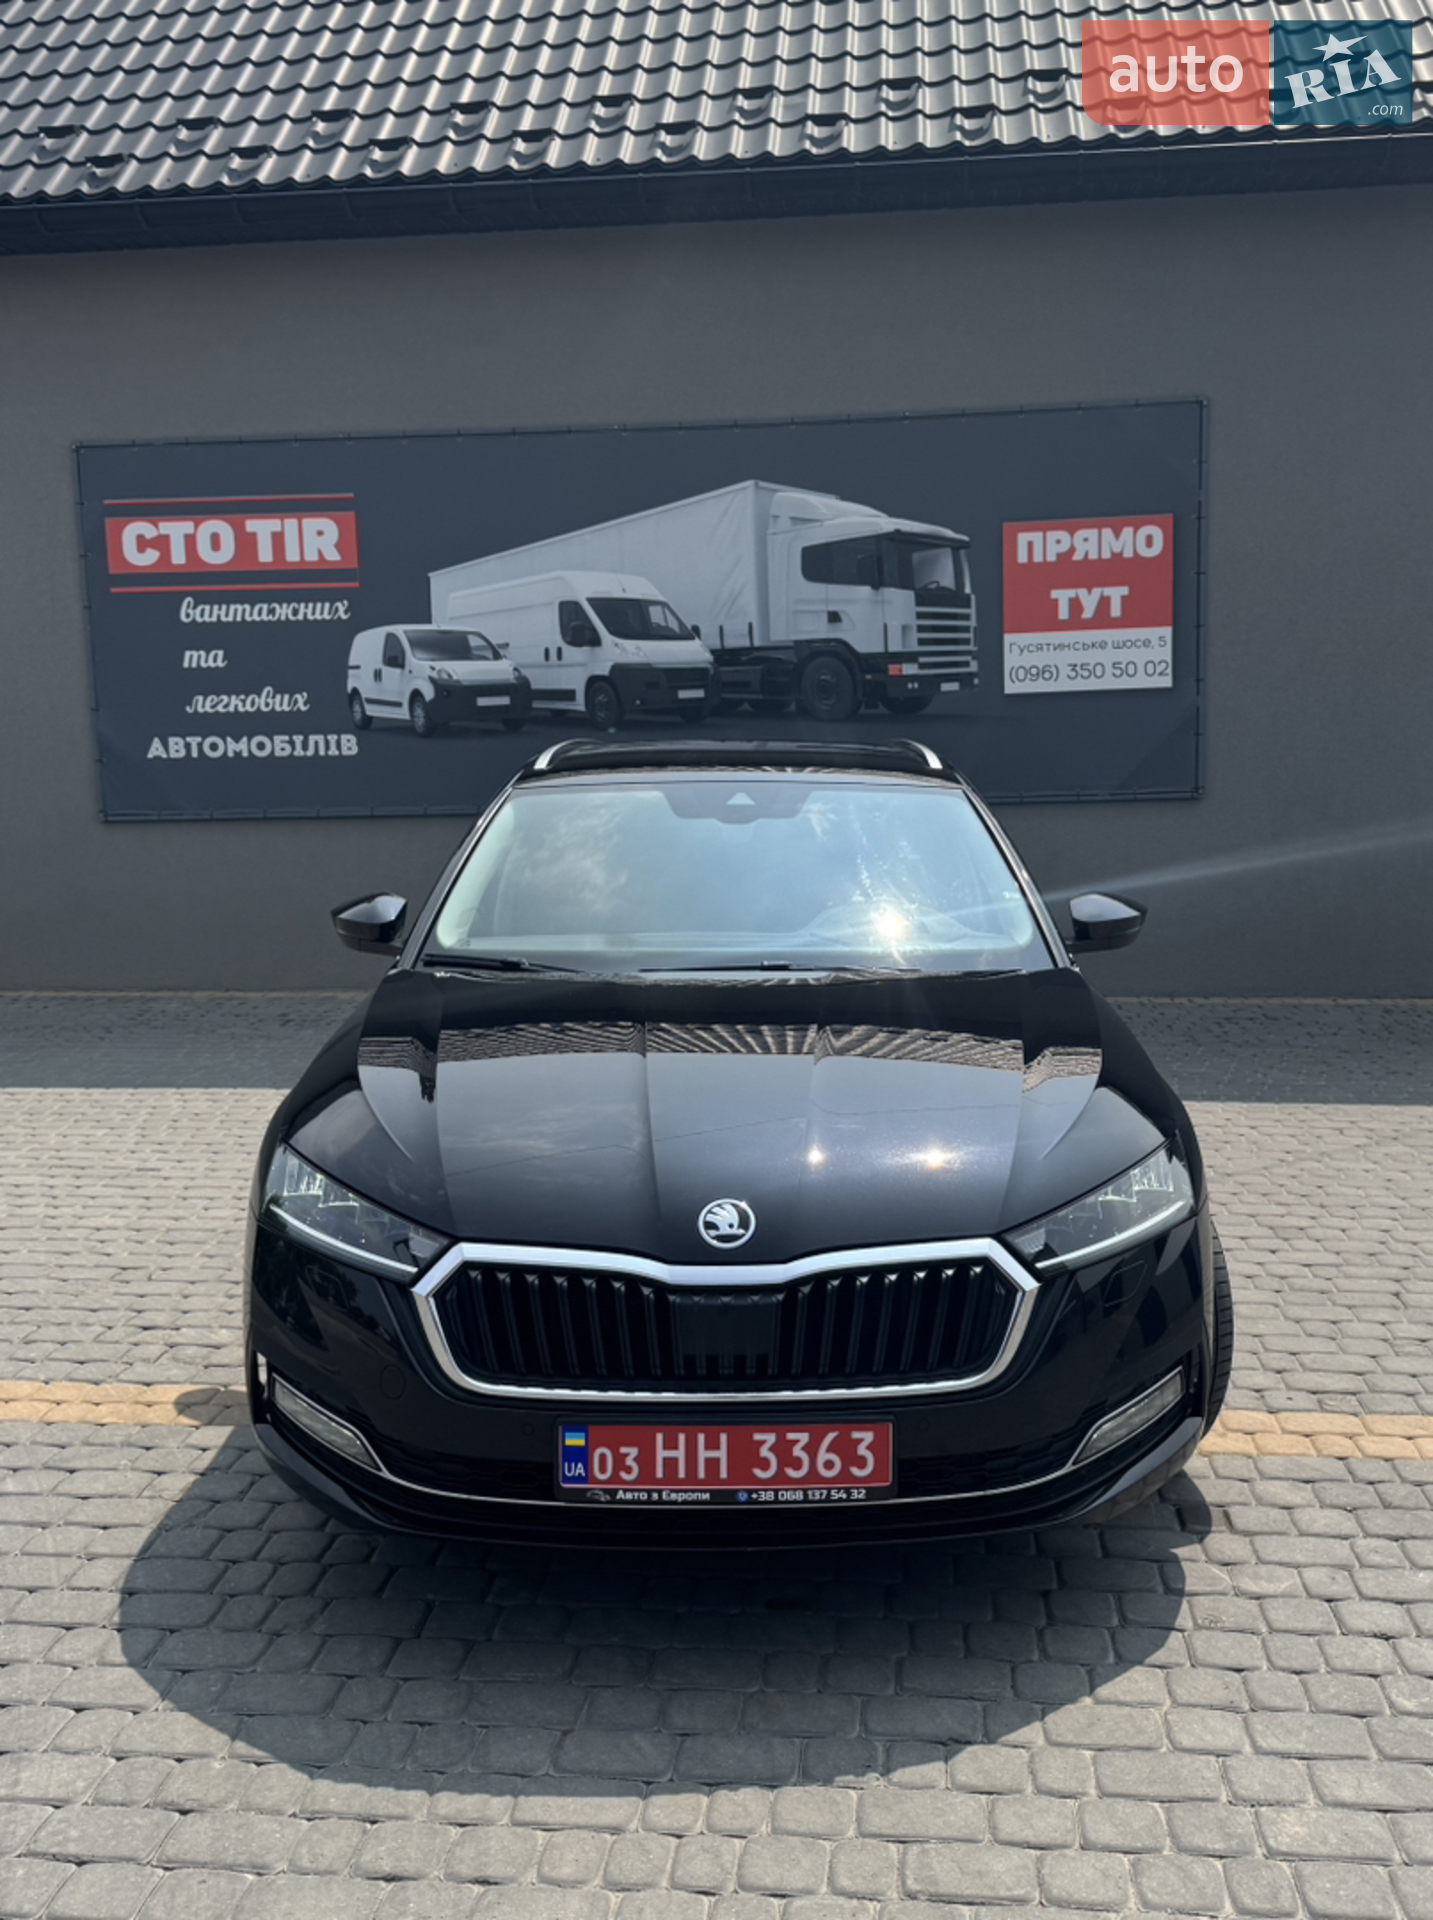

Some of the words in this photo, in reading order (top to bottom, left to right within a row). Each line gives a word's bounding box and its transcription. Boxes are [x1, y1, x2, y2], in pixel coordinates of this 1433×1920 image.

[121, 519, 236, 566] СТО
[245, 517, 341, 563] TIR
[1016, 525, 1164, 564] ПРЯМО
[179, 597, 350, 623] вантажних
[1051, 586, 1129, 620] ТУТ
[182, 649, 227, 669] та
[1009, 638, 1108, 656] Гусятинське
[1112, 637, 1155, 650] шосе,
[1158, 636, 1167, 648] 5
[1009, 664, 1060, 684] (096)
[1066, 662, 1105, 680] 350
[1112, 661, 1137, 679] 50
[1144, 659, 1169, 677] 02
[185, 686, 310, 713] легкових
[146, 733, 359, 759] АВТОМОБІЛІВ
[593, 1446, 639, 1481] 03
[752, 1431, 875, 1479] 3363
[564, 1462, 586, 1477] UA
[616, 1489, 648, 1500] Авто
[750, 1490, 775, 1501] +38
[807, 1489, 828, 1500] 137
[830, 1489, 847, 1499] 54
[850, 1488, 866, 1499] 32
